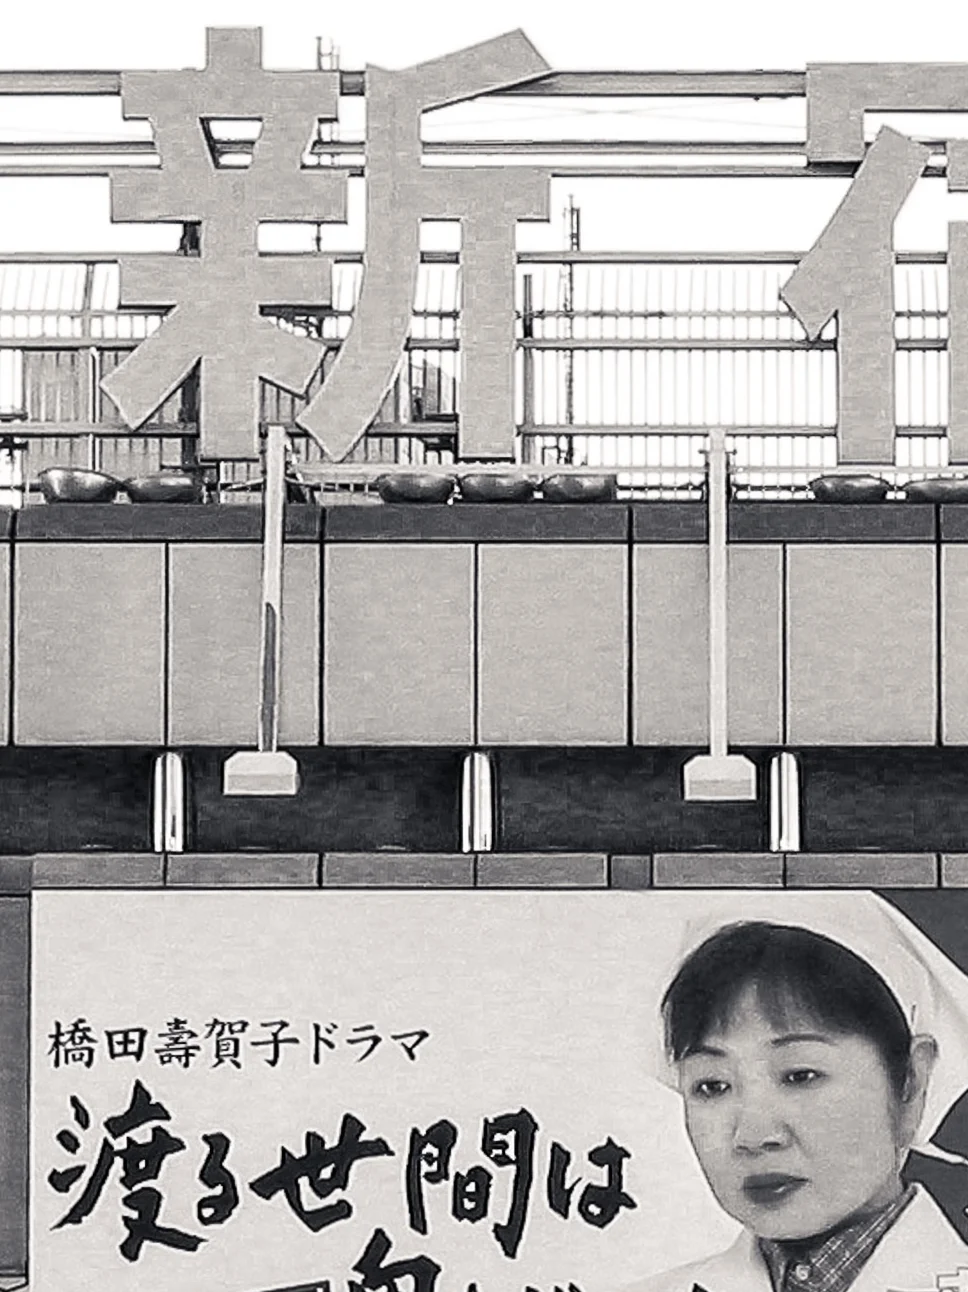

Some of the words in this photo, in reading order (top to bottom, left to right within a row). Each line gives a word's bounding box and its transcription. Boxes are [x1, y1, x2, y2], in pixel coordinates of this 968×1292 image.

[47, 1017, 430, 1069] 橋田壽賀子ドラマ
[48, 1080, 638, 1262] 渡る世間は
